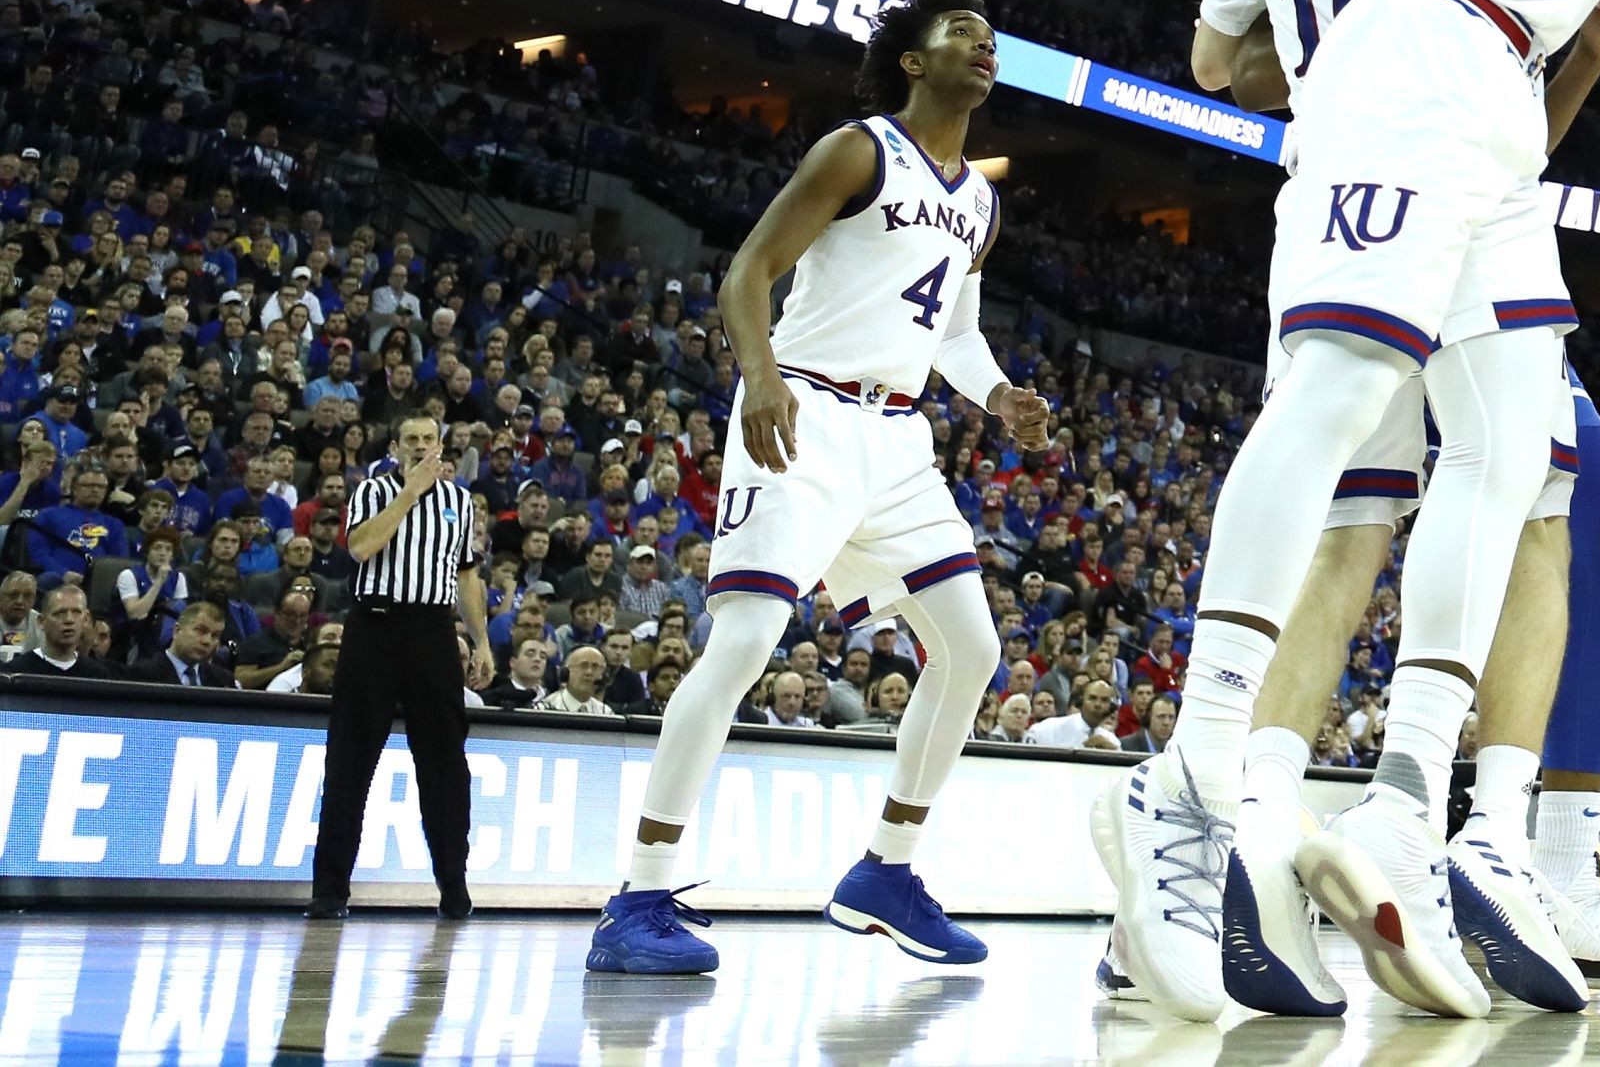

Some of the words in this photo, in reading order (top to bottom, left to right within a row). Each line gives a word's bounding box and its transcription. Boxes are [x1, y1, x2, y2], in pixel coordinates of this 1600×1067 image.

[1102, 77, 1267, 150] #MARCHMADNESS
[1320, 183, 1419, 251] KU
[901, 255, 943, 331] 4
